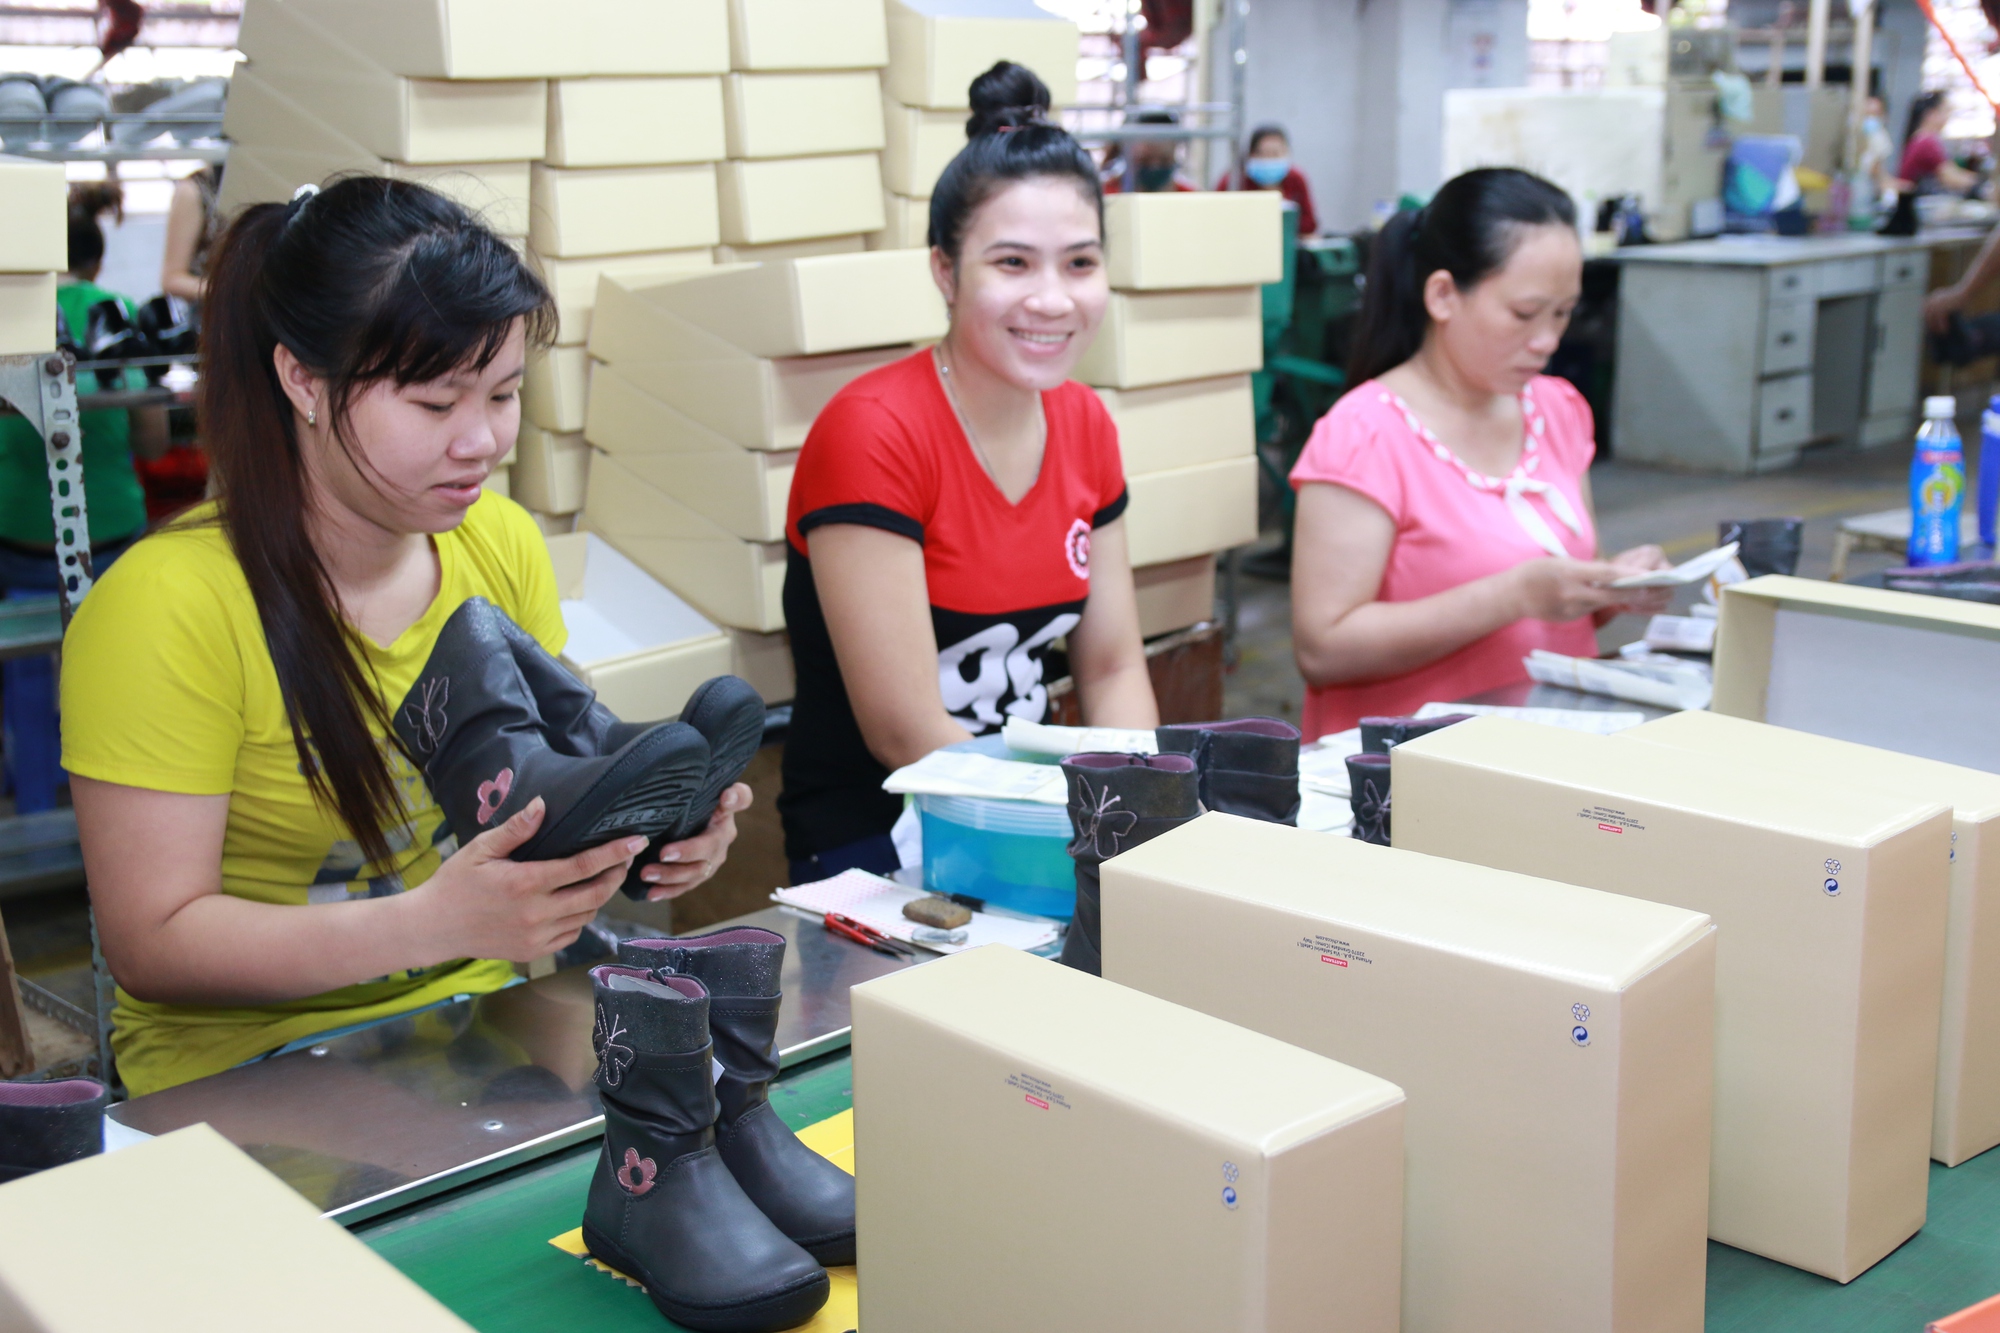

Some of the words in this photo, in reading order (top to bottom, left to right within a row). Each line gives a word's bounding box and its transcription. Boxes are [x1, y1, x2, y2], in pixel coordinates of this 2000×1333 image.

[594, 813, 644, 831] FLEX
[1315, 935, 1349, 946] www.chicco.com
[1355, 956, 1372, 964] Artsana
